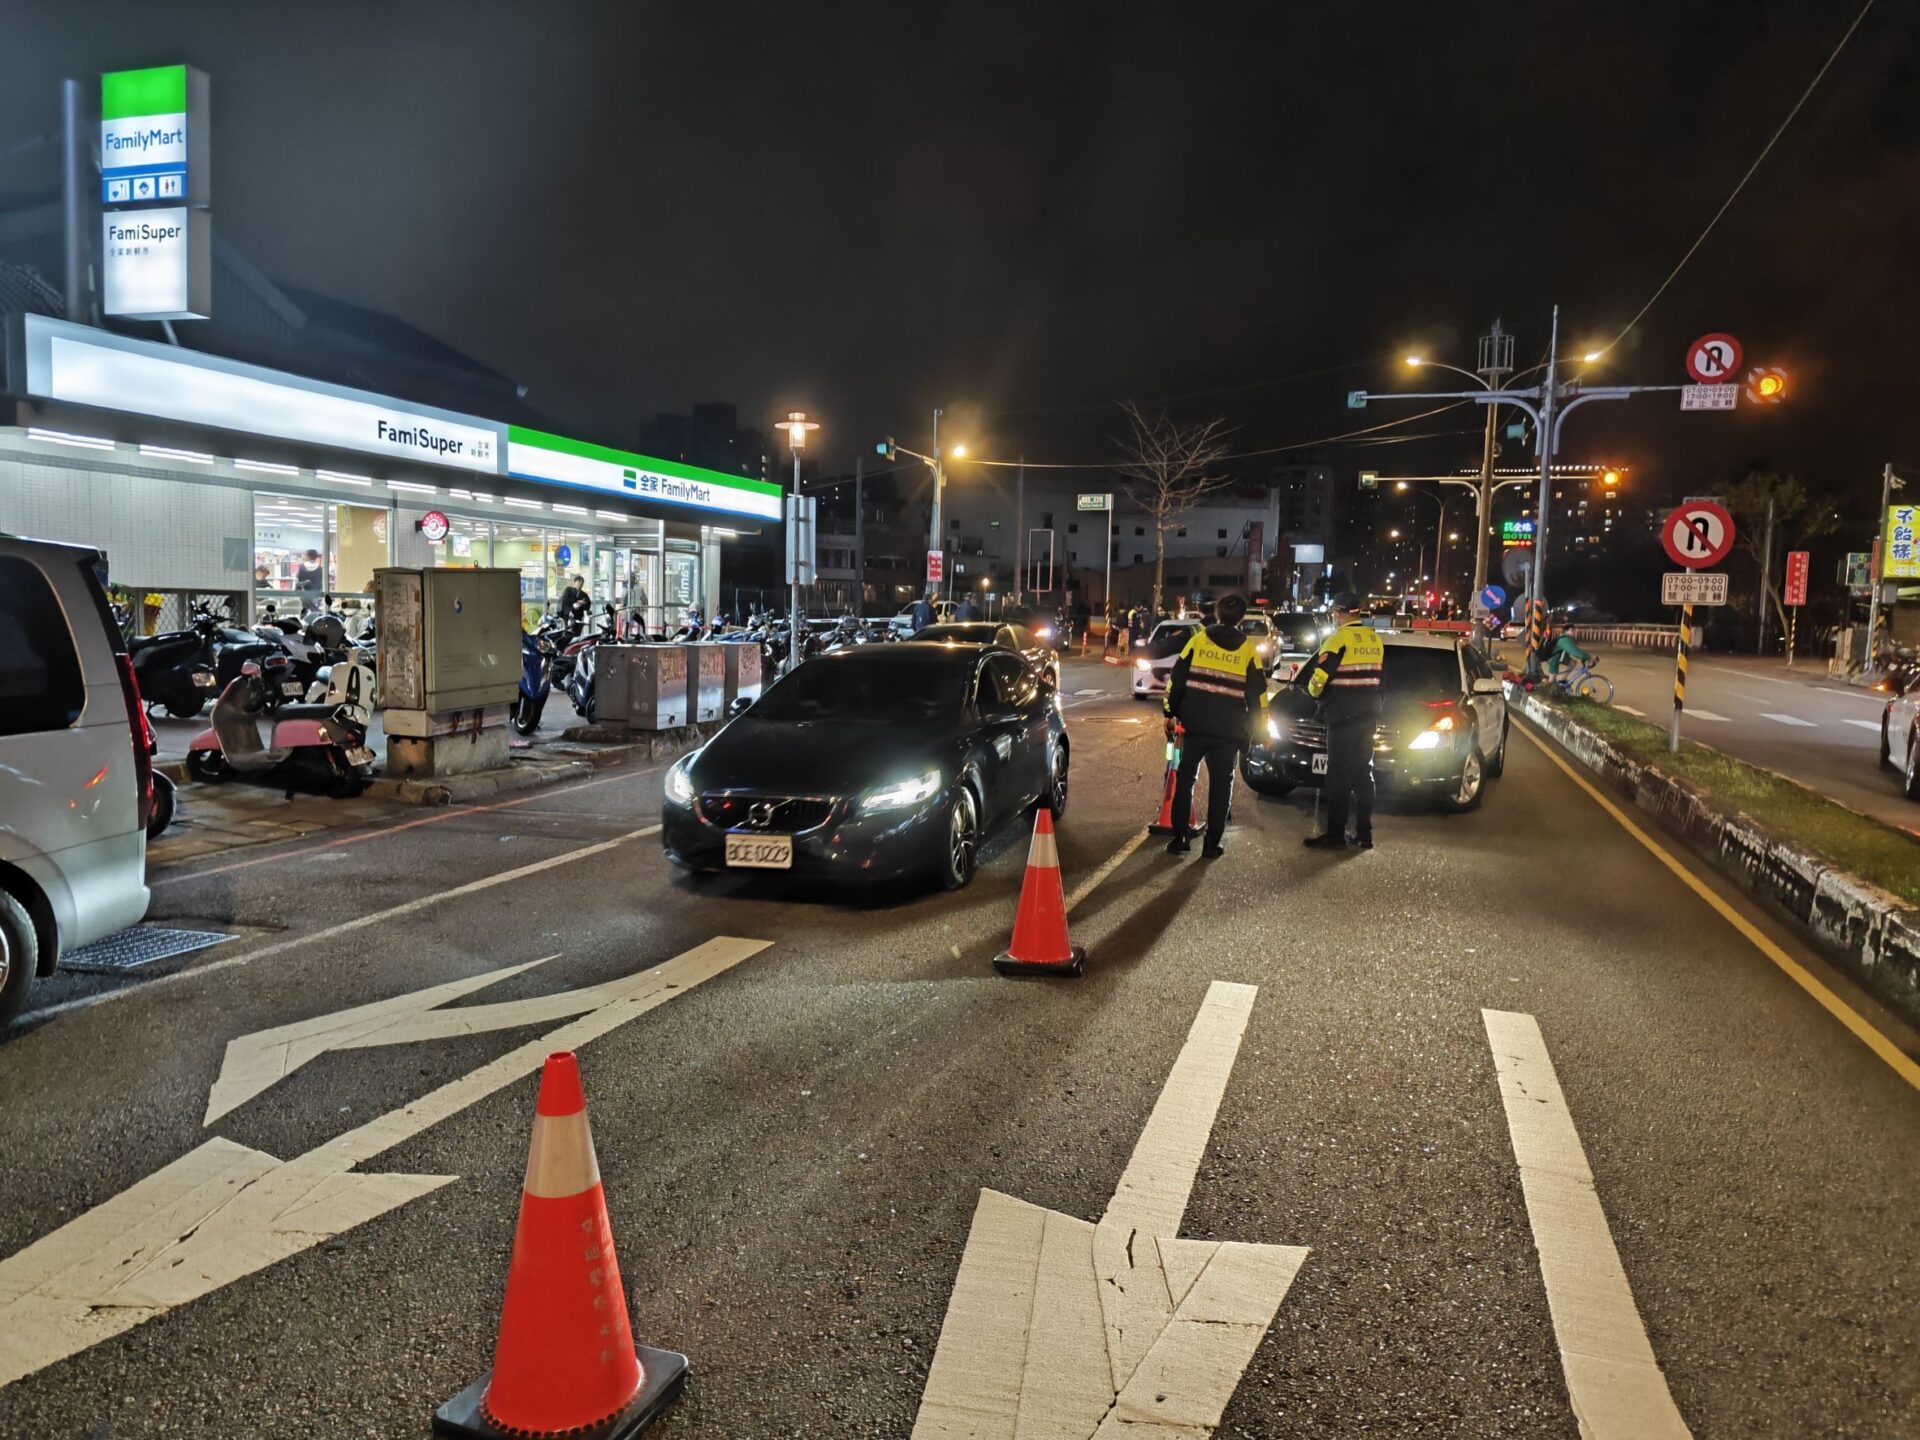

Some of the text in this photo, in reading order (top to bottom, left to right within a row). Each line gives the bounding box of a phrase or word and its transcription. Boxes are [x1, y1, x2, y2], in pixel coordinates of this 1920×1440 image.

[105, 128, 183, 151] FamilyMart
[109, 223, 181, 243] FamiSuper
[378, 419, 463, 456] FamiSuper
[640, 474, 710, 502] 全家 FamilyMart
[1667, 576, 1724, 584] 07:00-09:00
[1667, 584, 1723, 592] 17:00-19:00
[1198, 649, 1241, 664] POLICE
[1353, 647, 1381, 656] POLICE
